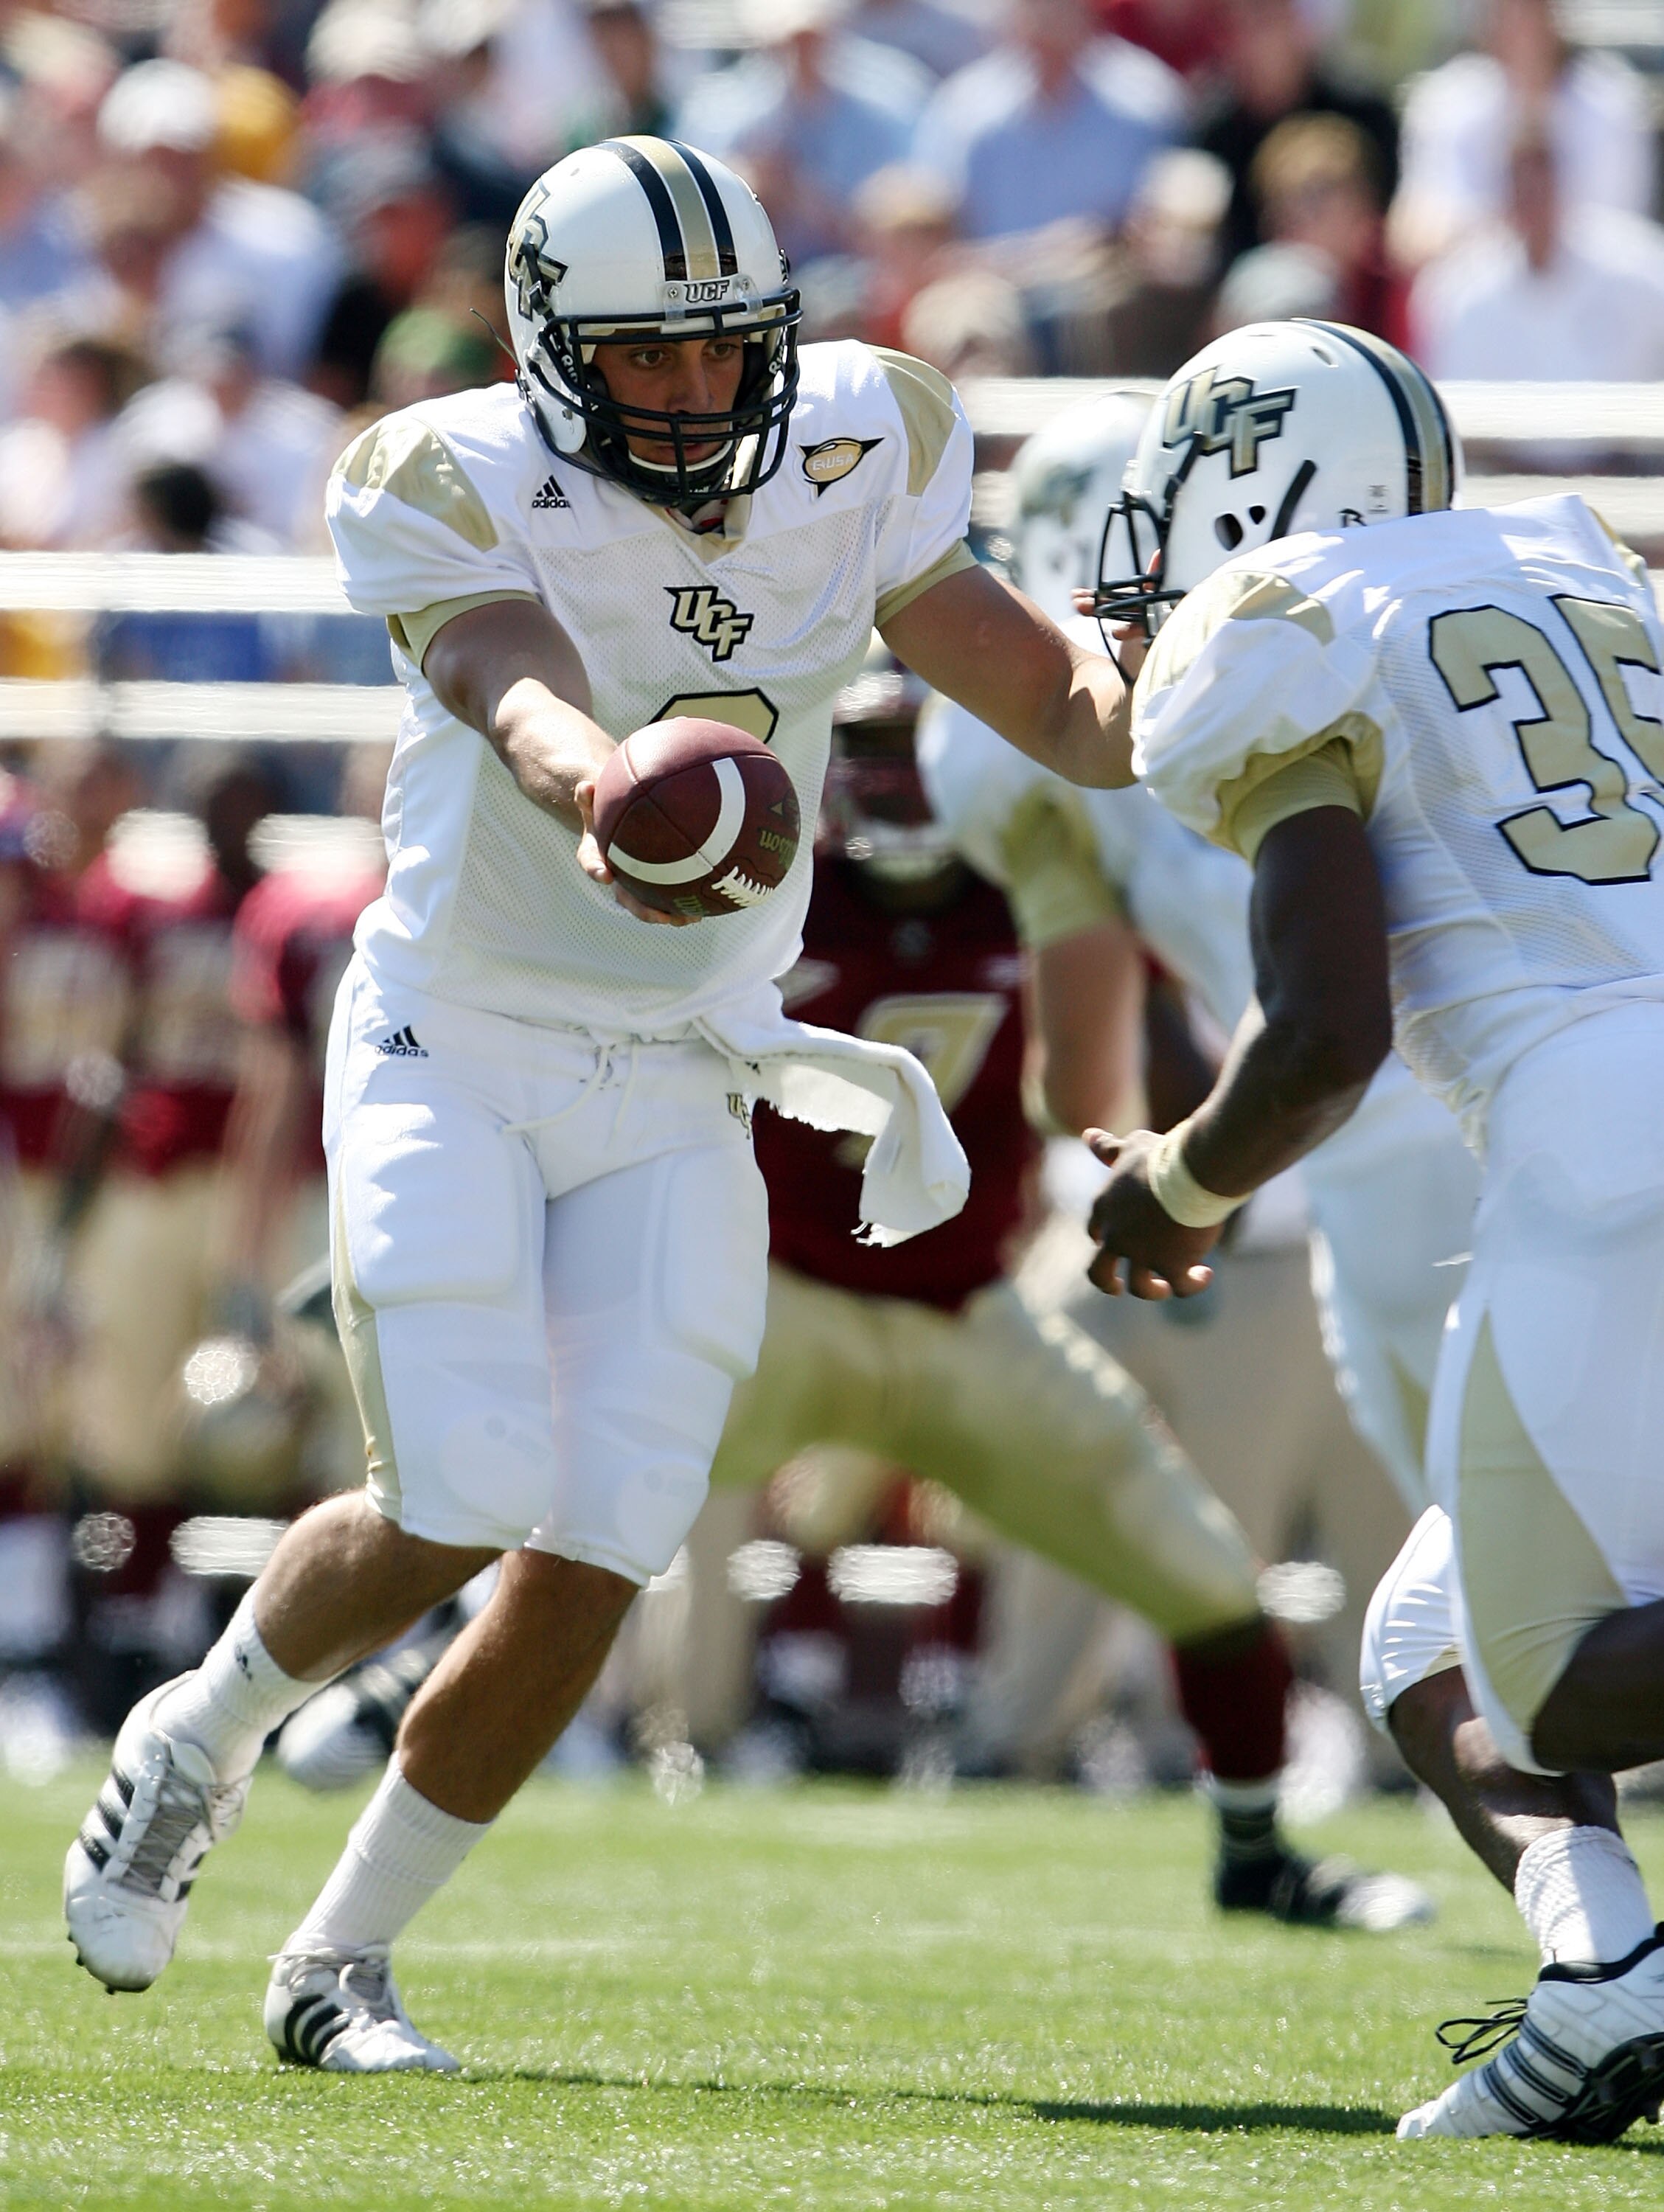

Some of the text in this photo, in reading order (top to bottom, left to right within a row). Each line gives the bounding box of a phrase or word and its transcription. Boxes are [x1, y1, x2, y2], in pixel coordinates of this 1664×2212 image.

[683, 279, 730, 303] UCF
[1162, 365, 1298, 479] UCF
[664, 585, 753, 662] UCF
[375, 1045, 429, 1057] adidas
